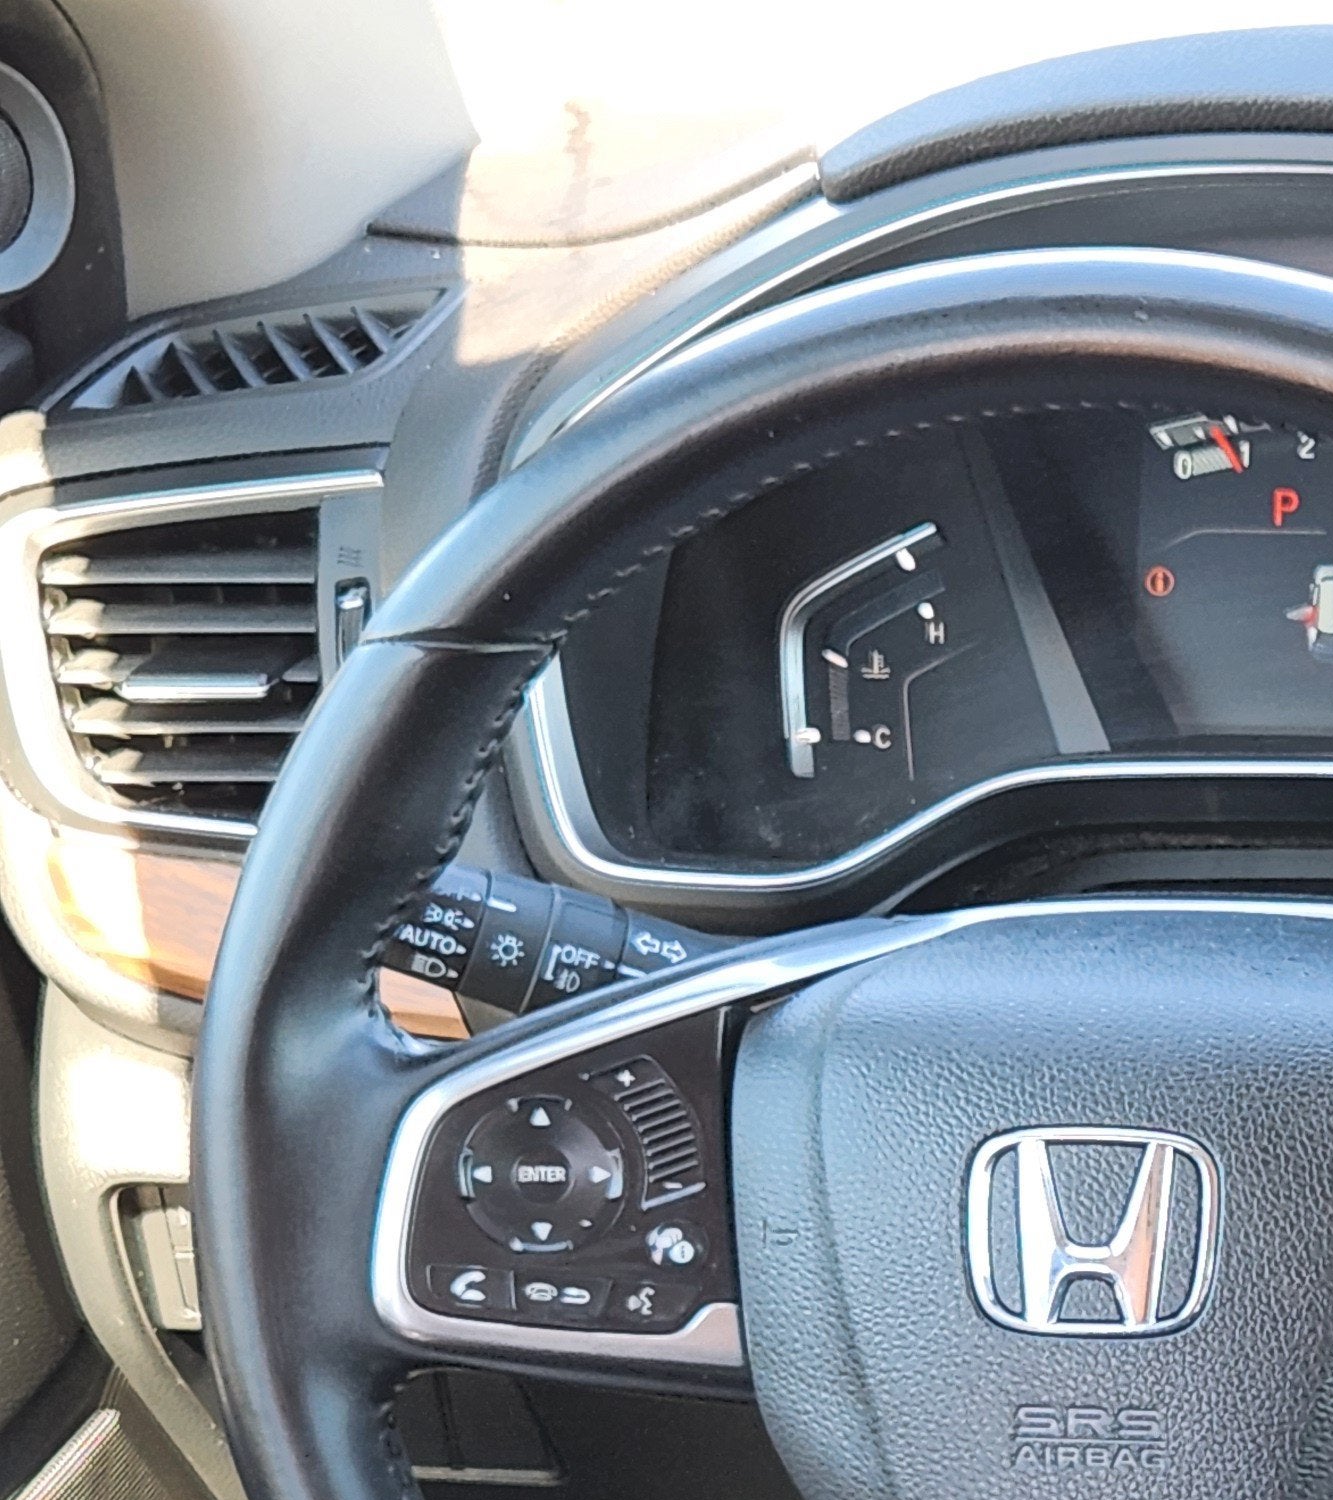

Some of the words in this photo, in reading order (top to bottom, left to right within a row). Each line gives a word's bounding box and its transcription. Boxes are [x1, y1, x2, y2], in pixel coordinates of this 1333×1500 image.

[1272, 486, 1300, 528] P
[927, 621, 945, 645] H
[872, 724, 893, 750] C
[399, 923, 457, 956] AUTO
[560, 943, 601, 970] OFF
[517, 1165, 566, 1184] ENTER
[1016, 1405, 1164, 1438] SRS
[1011, 1445, 1172, 1473] AIRBAG
